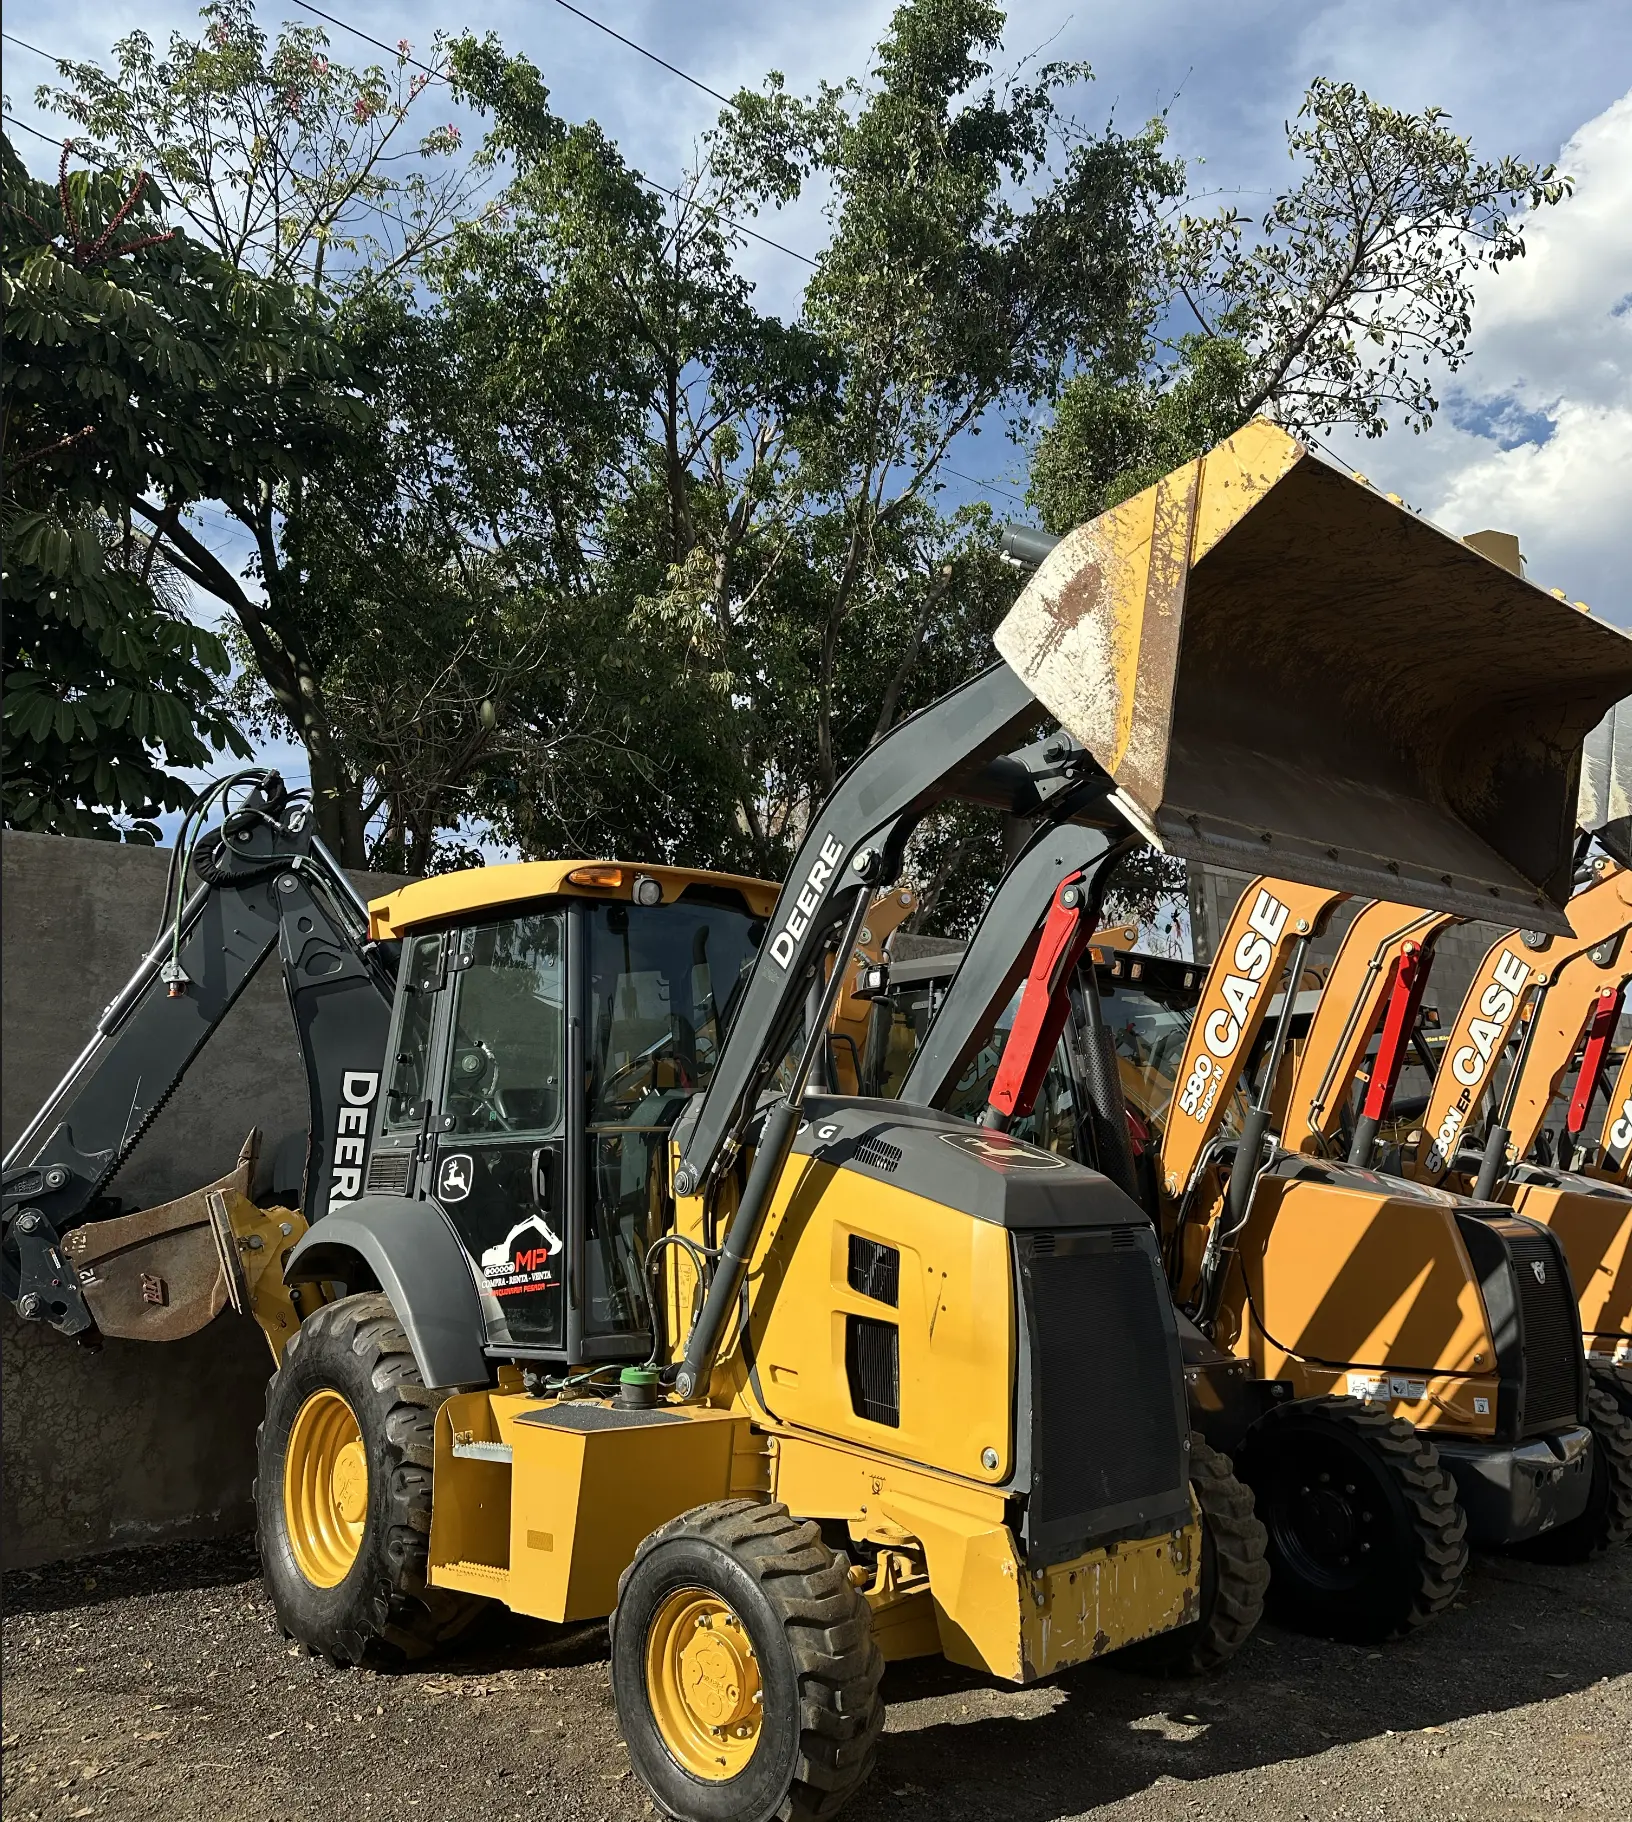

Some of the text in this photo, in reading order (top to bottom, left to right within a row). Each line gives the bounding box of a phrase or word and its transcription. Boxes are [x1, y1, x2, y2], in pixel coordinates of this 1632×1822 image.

[769, 833, 844, 970] DEERE
[1204, 887, 1290, 1058] CASE
[1452, 949, 1531, 1087] CASE
[1178, 1054, 1212, 1116] 580
[1195, 1064, 1224, 1124] Super N
[79, 1268, 97, 1285] 12
[481, 1270, 552, 1288] COMPRA RENTA VENTA
[515, 1248, 547, 1273] MP
